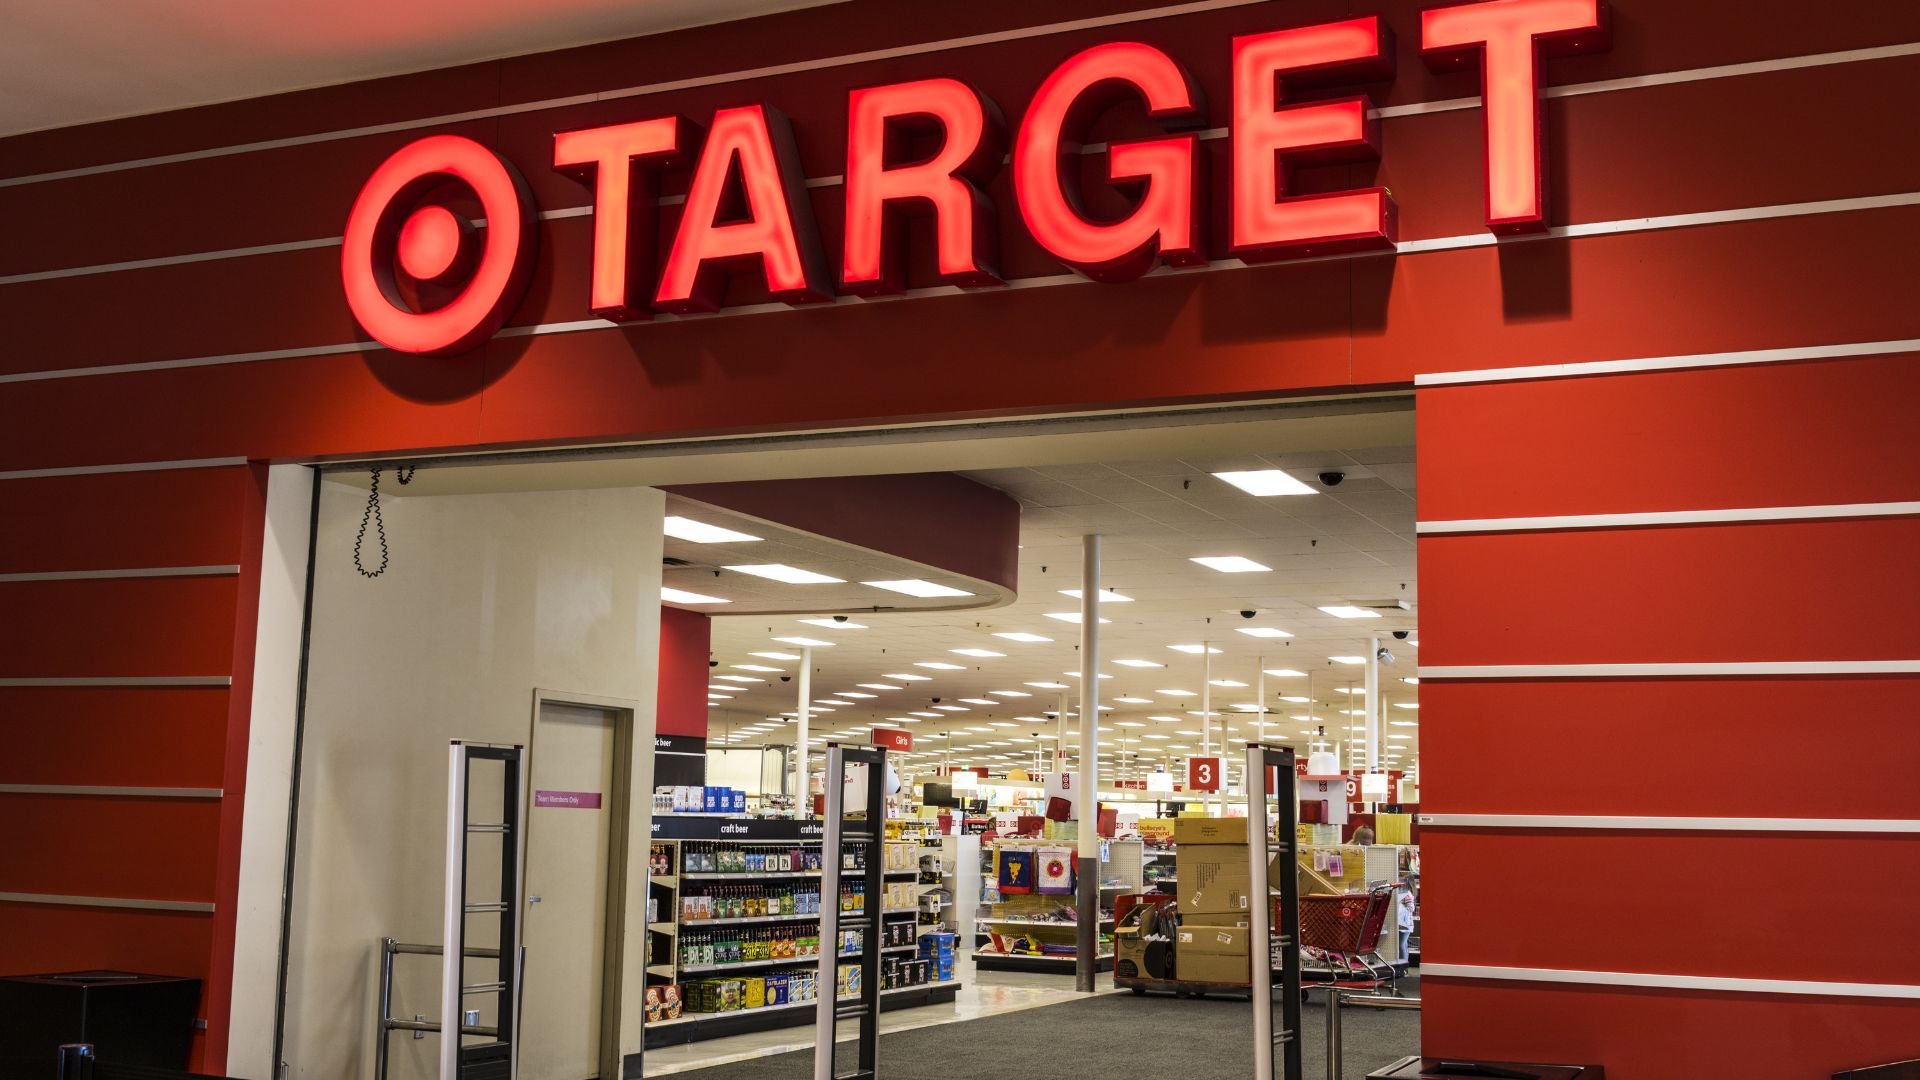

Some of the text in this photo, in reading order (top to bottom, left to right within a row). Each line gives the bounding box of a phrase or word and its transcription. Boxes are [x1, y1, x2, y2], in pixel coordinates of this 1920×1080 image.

[552, 0, 1600, 311] TARGET
[660, 738, 672, 747] beer
[896, 736, 908, 745] Girls
[1198, 764, 1212, 784] 3
[721, 824, 748, 834] craft beer
[800, 825, 812, 834] craft
